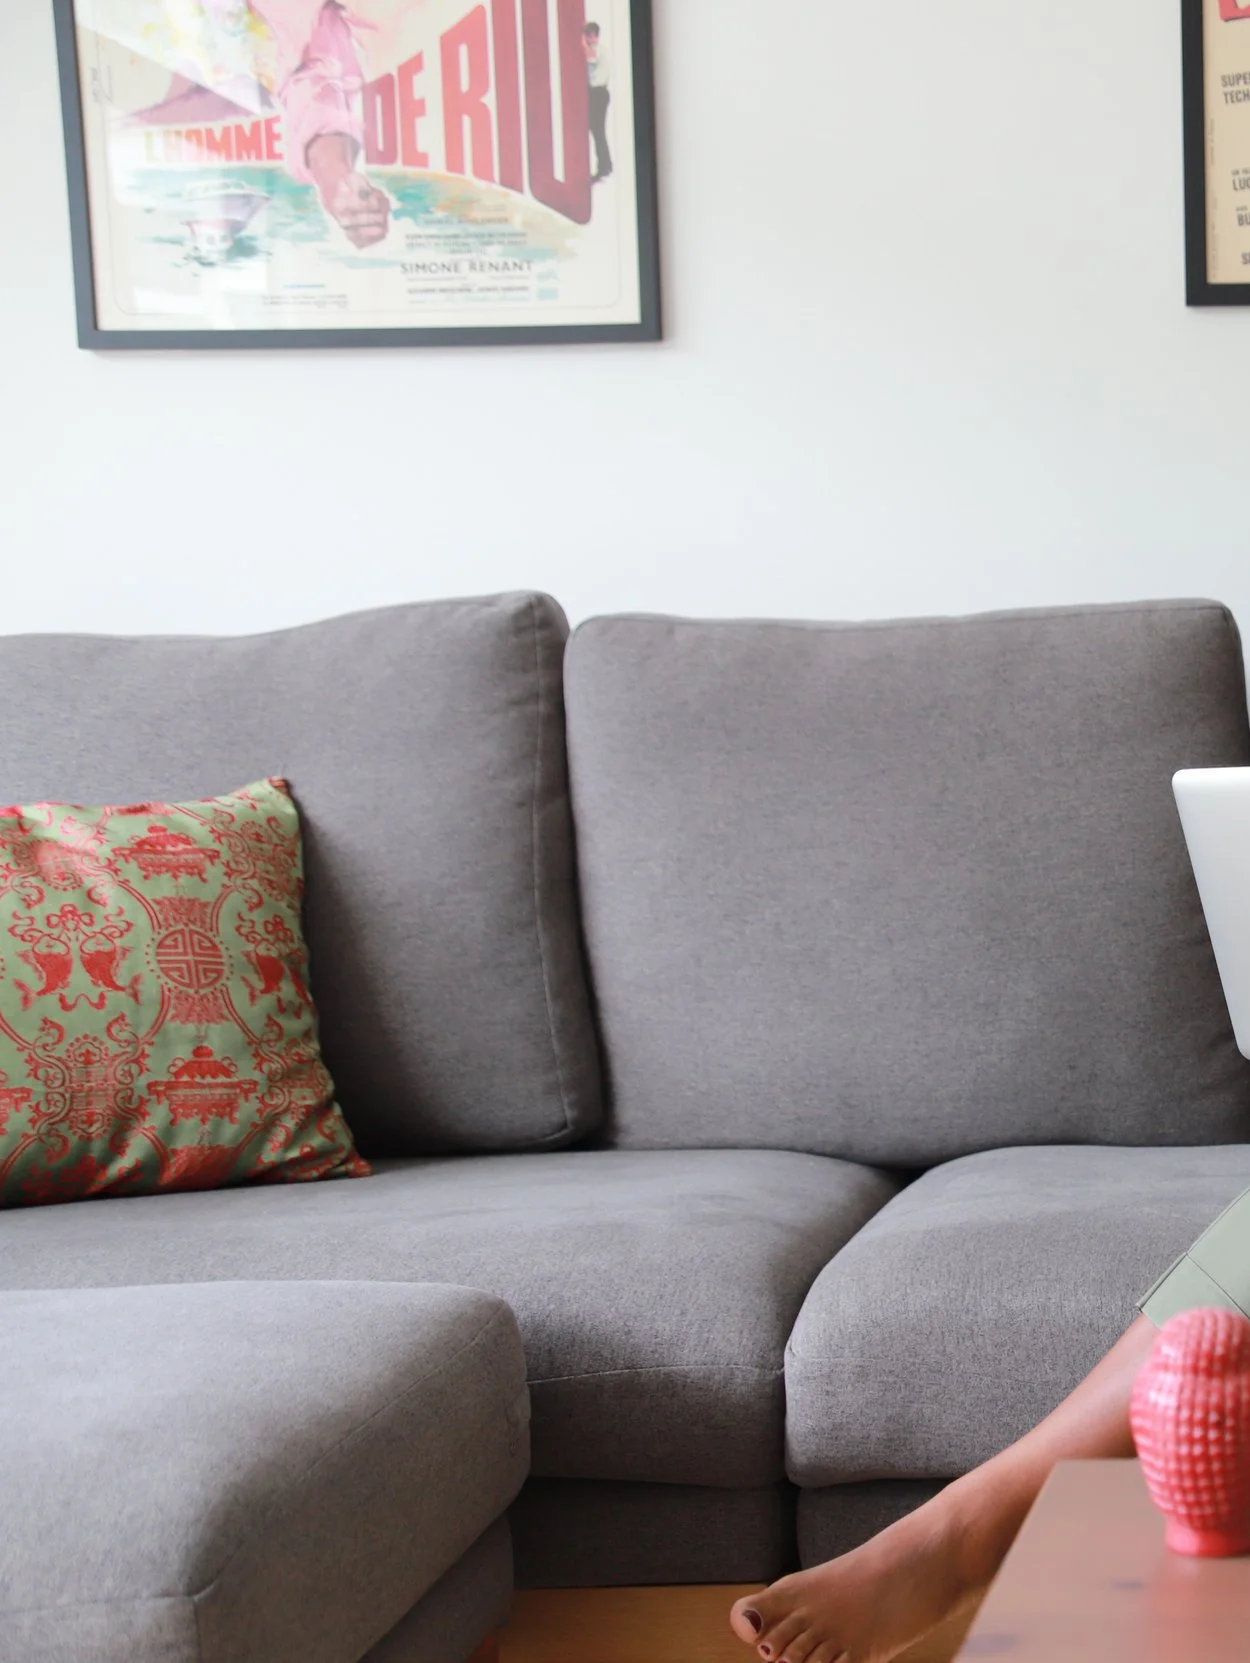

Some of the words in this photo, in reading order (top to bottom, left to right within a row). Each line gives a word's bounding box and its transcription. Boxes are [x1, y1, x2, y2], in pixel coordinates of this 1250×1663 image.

[363, 50, 429, 168] DE
[400, 261, 463, 275] SIMONE
[468, 260, 533, 274] RENANT
